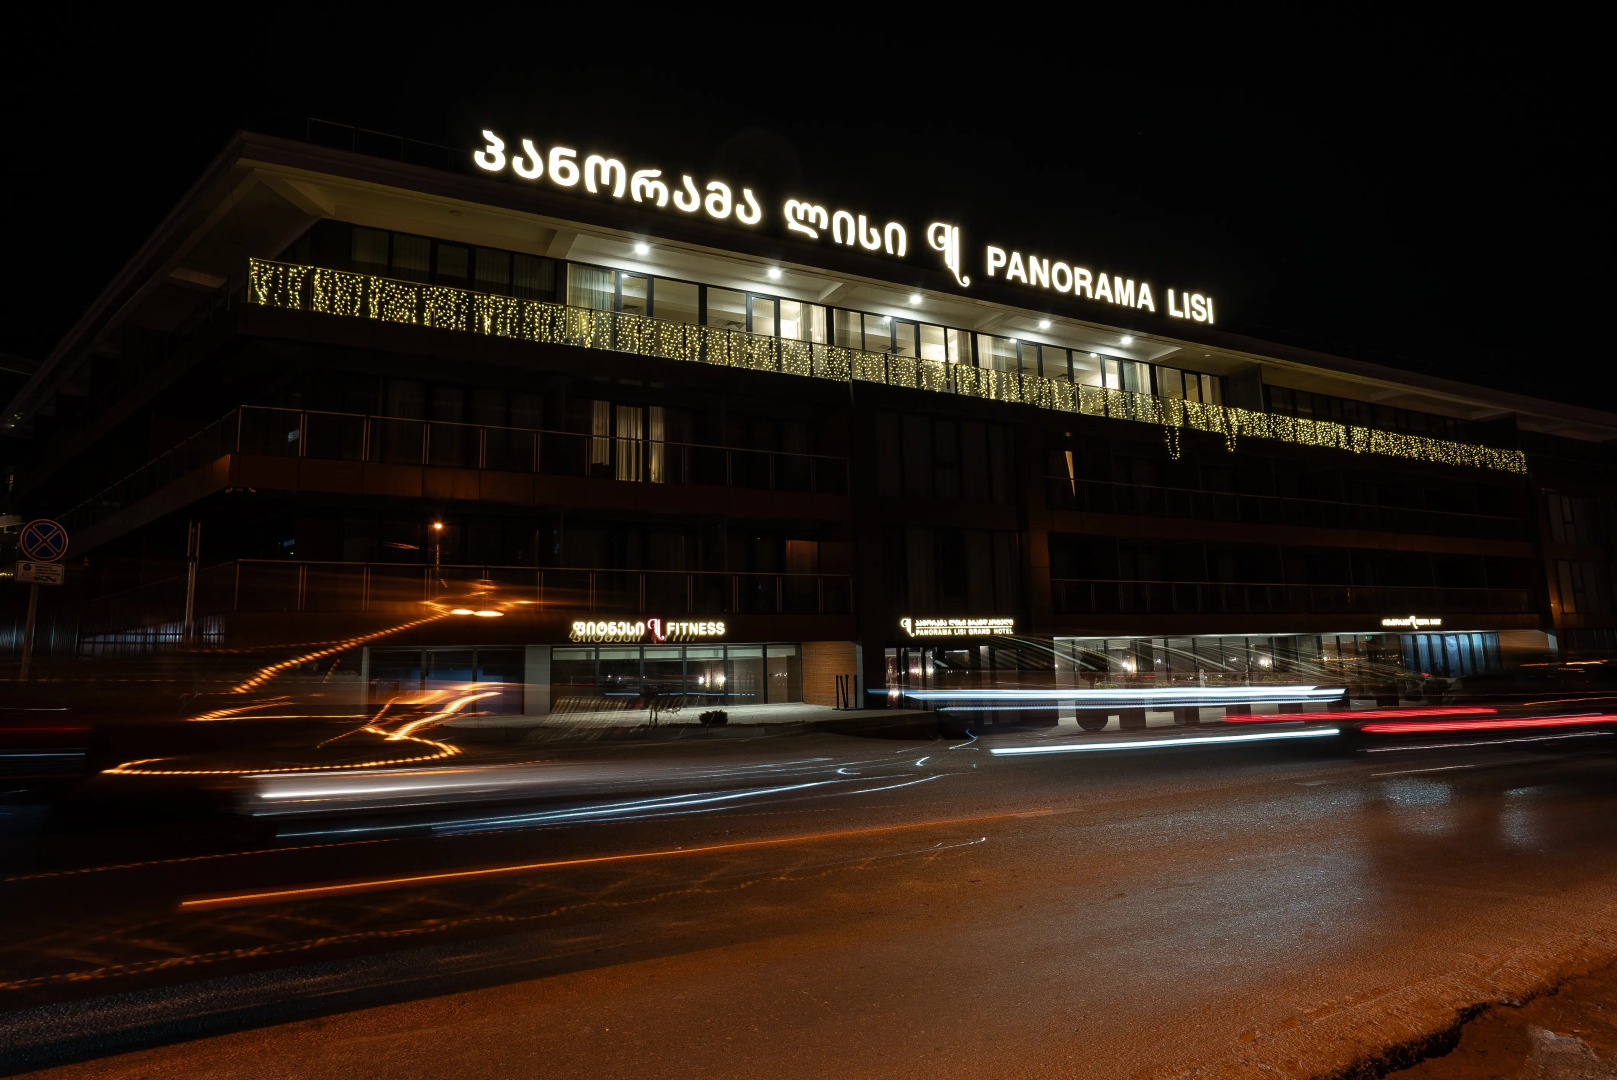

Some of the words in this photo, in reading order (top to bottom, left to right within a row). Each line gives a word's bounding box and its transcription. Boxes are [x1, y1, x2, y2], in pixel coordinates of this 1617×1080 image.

[473, 129, 762, 225] პანორამა
[783, 199, 907, 257] ლისი
[987, 245, 1155, 312] PANORAMA
[1167, 288, 1214, 324] LISI
[572, 621, 646, 637] ფიტნესი
[666, 621, 726, 636] FITNESS
[915, 628, 952, 636] PANORAMA
